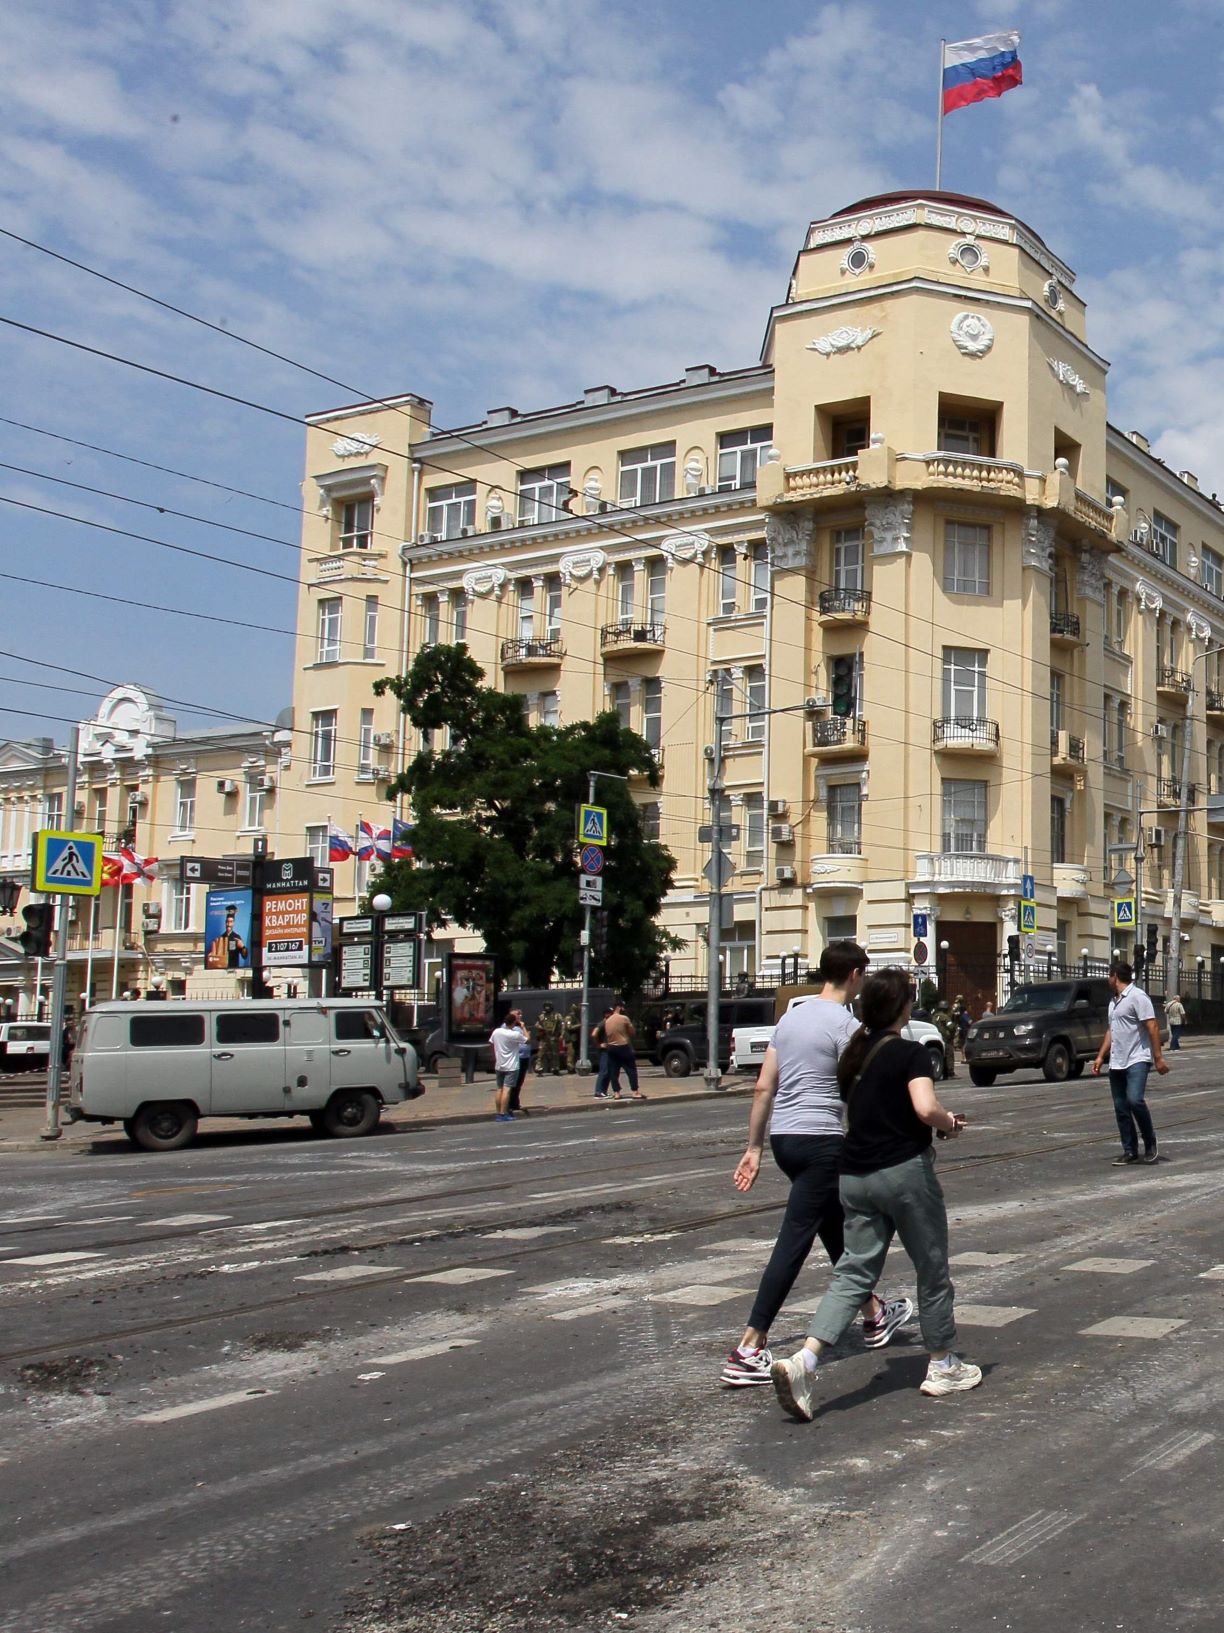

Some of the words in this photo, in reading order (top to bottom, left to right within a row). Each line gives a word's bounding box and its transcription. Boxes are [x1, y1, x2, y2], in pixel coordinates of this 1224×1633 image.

[266, 880, 308, 889] MANHATTAN
[266, 898, 307, 912] РЕМОНТ
[265, 913, 307, 927] КВАРТИР
